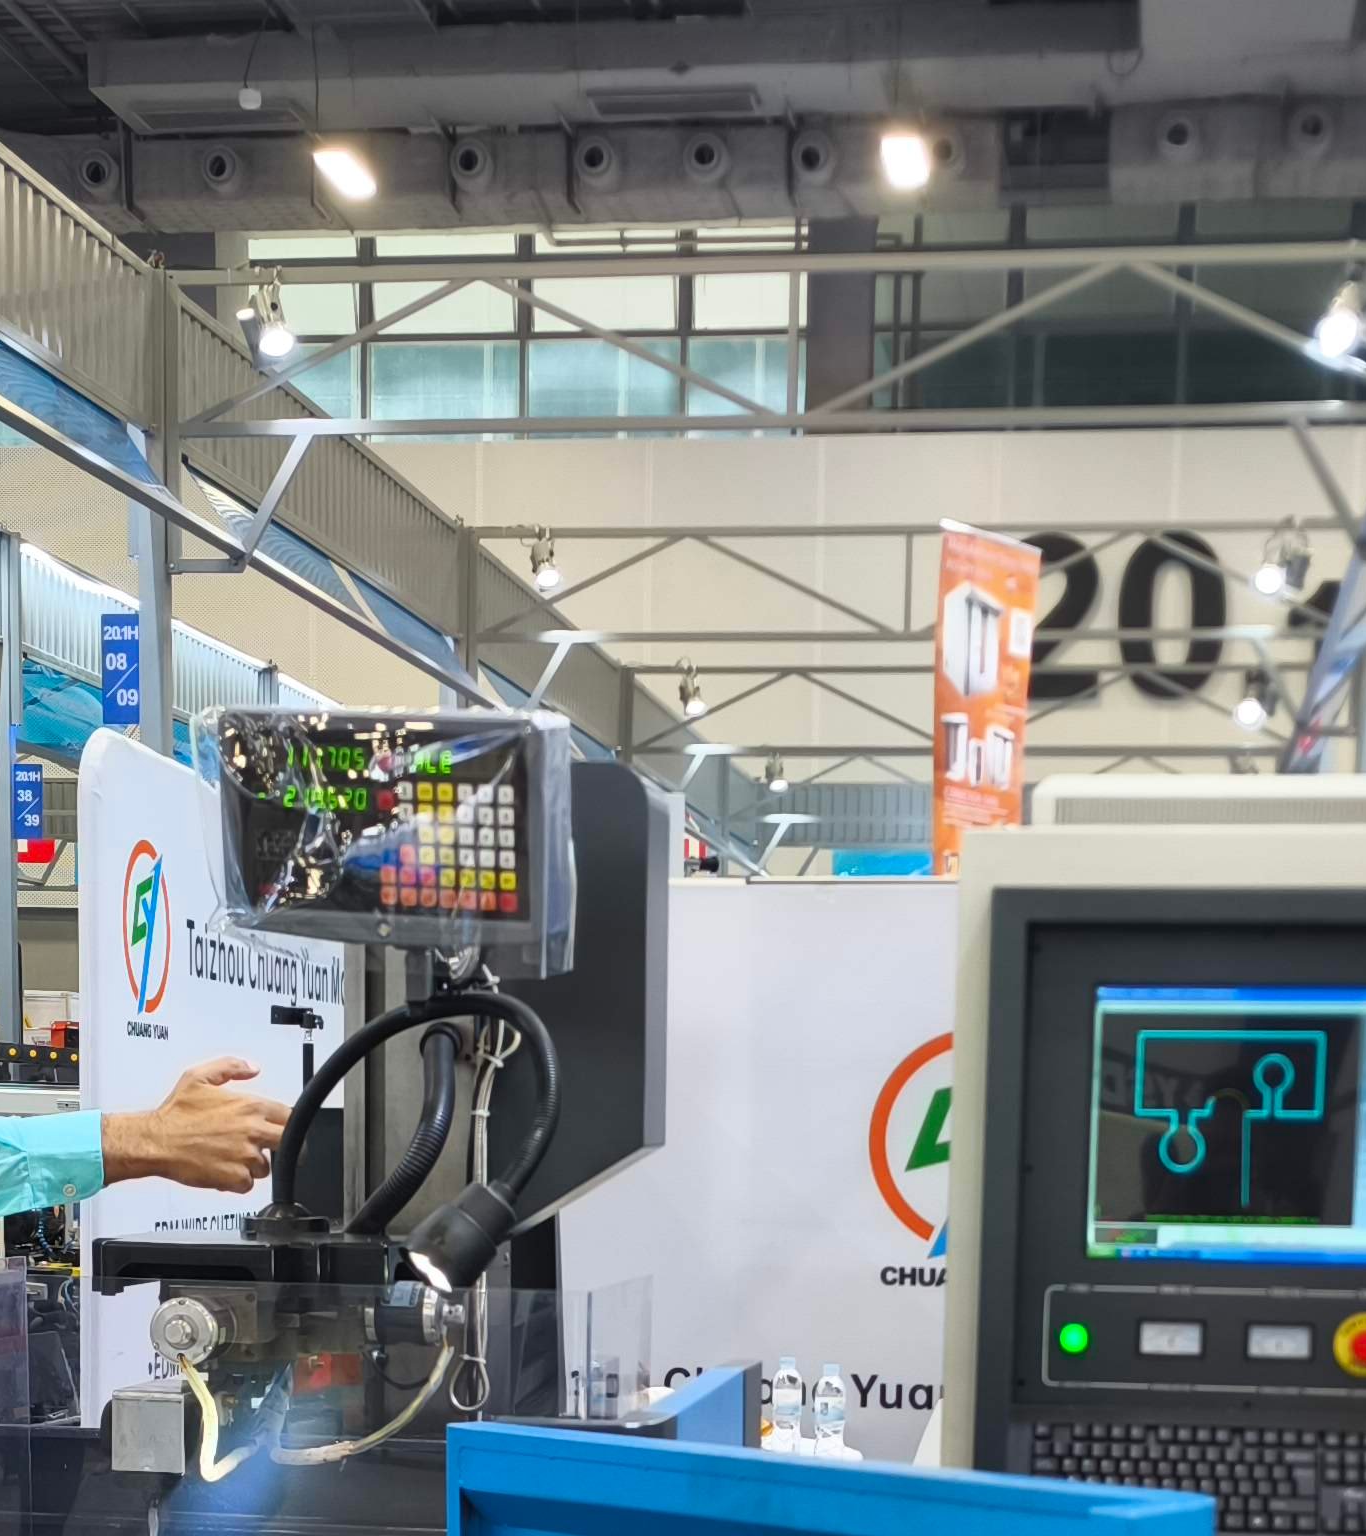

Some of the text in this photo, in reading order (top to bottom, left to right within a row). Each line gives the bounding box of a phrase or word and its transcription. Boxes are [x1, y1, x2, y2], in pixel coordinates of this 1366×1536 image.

[103, 626, 139, 641] 20.1H
[105, 653, 127, 671] 08
[116, 688, 139, 706] 09
[17, 789, 33, 802] 38
[23, 814, 40, 827] 39
[186, 918, 244, 987] Taizhou
[300, 947, 329, 1003] Yuan
[126, 1020, 169, 1041] CHUANG YUAN
[851, 1373, 944, 1411] Yua
